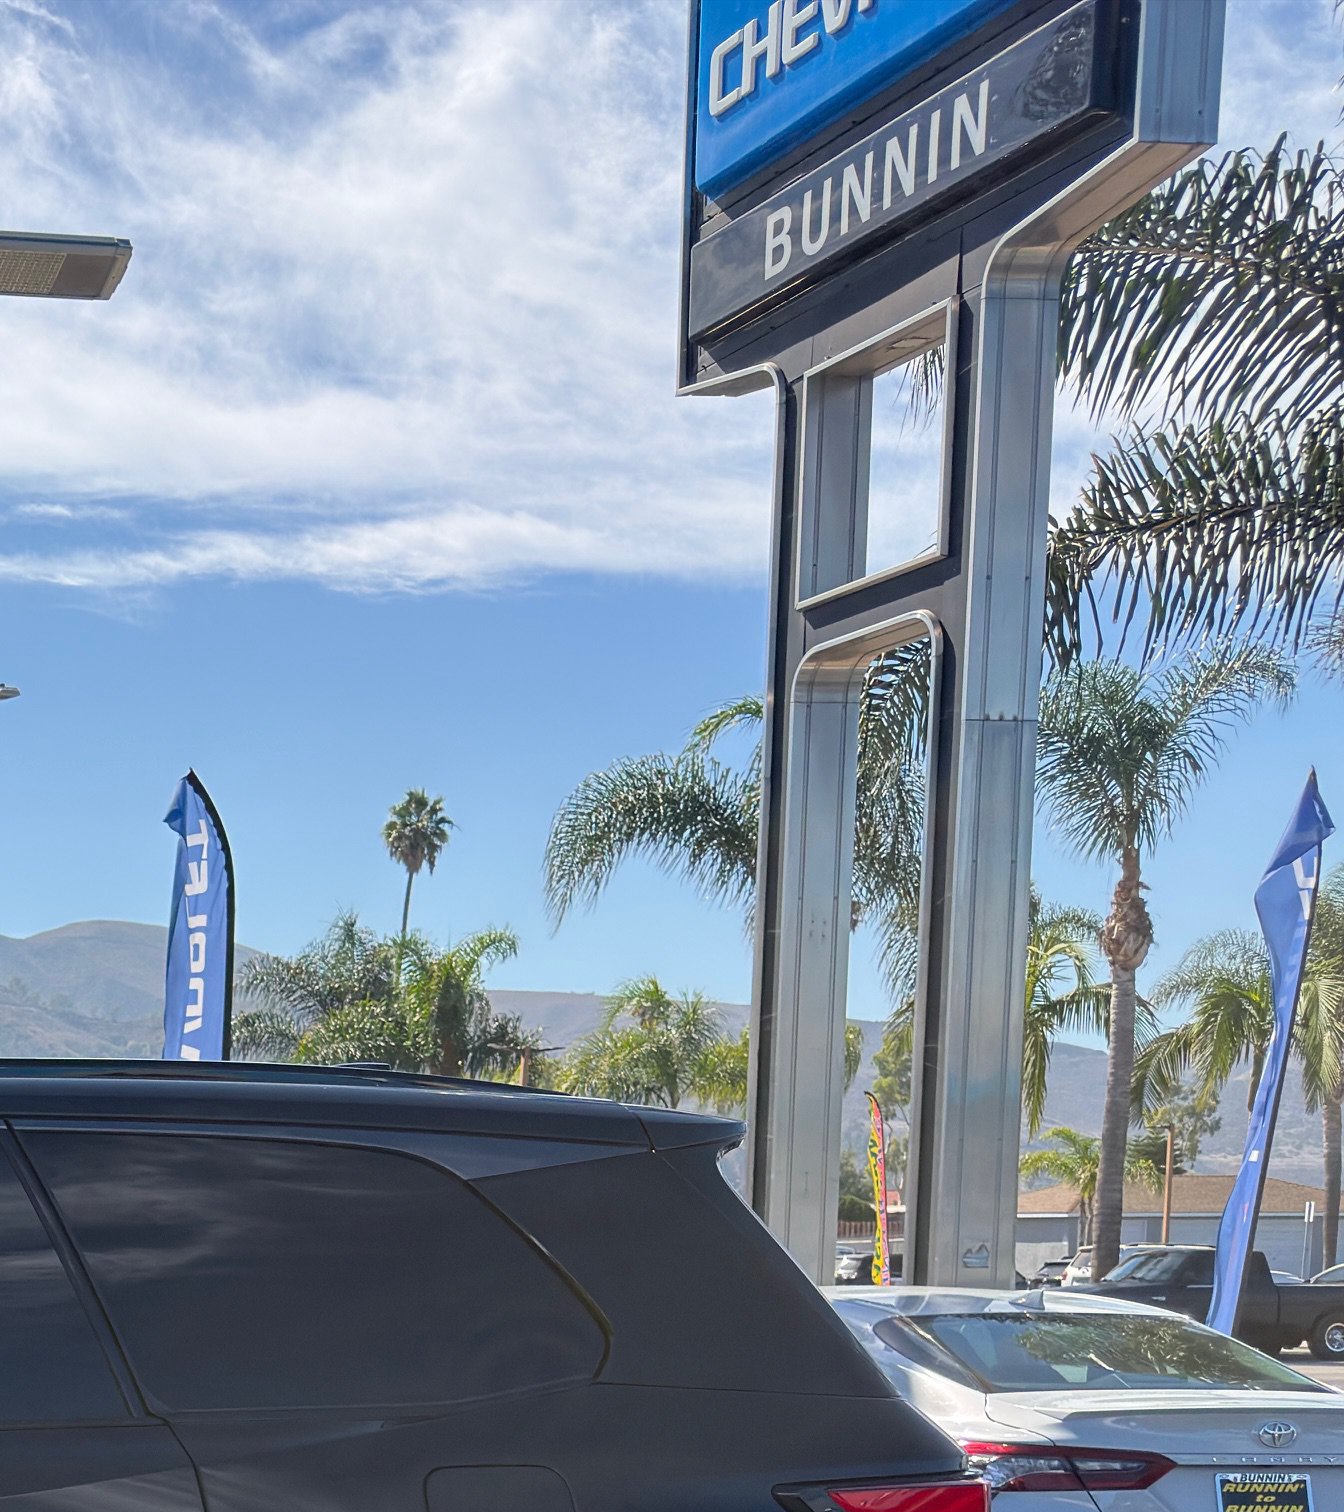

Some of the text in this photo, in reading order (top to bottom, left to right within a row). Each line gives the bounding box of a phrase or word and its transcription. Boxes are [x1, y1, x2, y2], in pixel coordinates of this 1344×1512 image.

[708, 0, 874, 118] CHE
[763, 78, 990, 281] BUNNIN
[1239, 1473, 1286, 1483] BUNNIN
[1222, 1482, 1304, 1493] RUNNIN'
[1255, 1493, 1276, 1503] to
